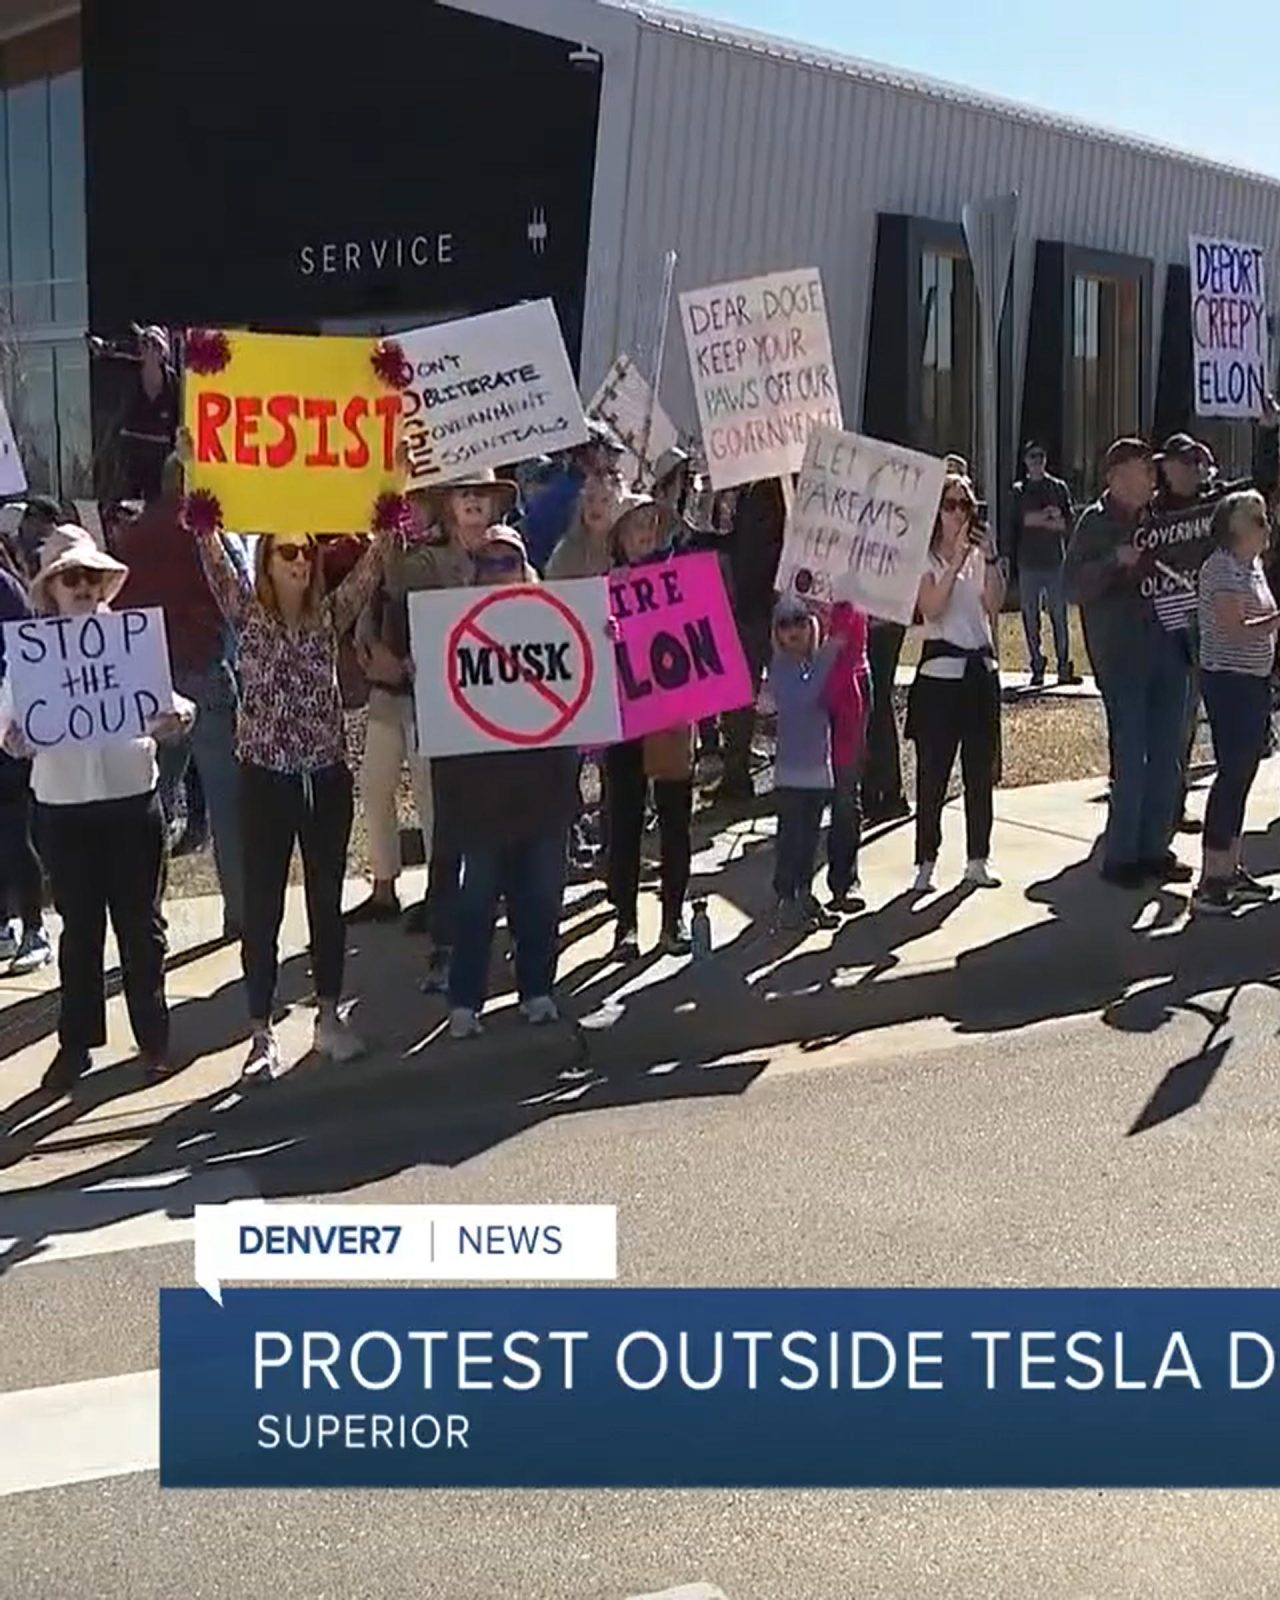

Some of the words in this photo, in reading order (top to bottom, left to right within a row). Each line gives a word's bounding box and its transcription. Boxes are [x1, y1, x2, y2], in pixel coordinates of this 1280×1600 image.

[300, 234, 453, 275] SERVICE
[1195, 243, 1262, 296] DEPORT
[689, 295, 752, 336] DEAR
[762, 281, 823, 320] DOGE
[1193, 294, 1264, 356] CREEPY
[696, 337, 747, 378] KEEP
[753, 327, 808, 367] YOUR
[704, 379, 759, 418] PAWS
[764, 370, 793, 405] OFF
[797, 364, 835, 400] OUR
[1199, 360, 1268, 415] ELON
[196, 391, 402, 472] RESIST
[799, 480, 910, 538] PARENTS
[609, 569, 684, 619] IRE
[17, 611, 149, 664] STOP
[614, 614, 726, 702] LON
[457, 641, 573, 689] MUSK
[25, 689, 160, 746] COUP
